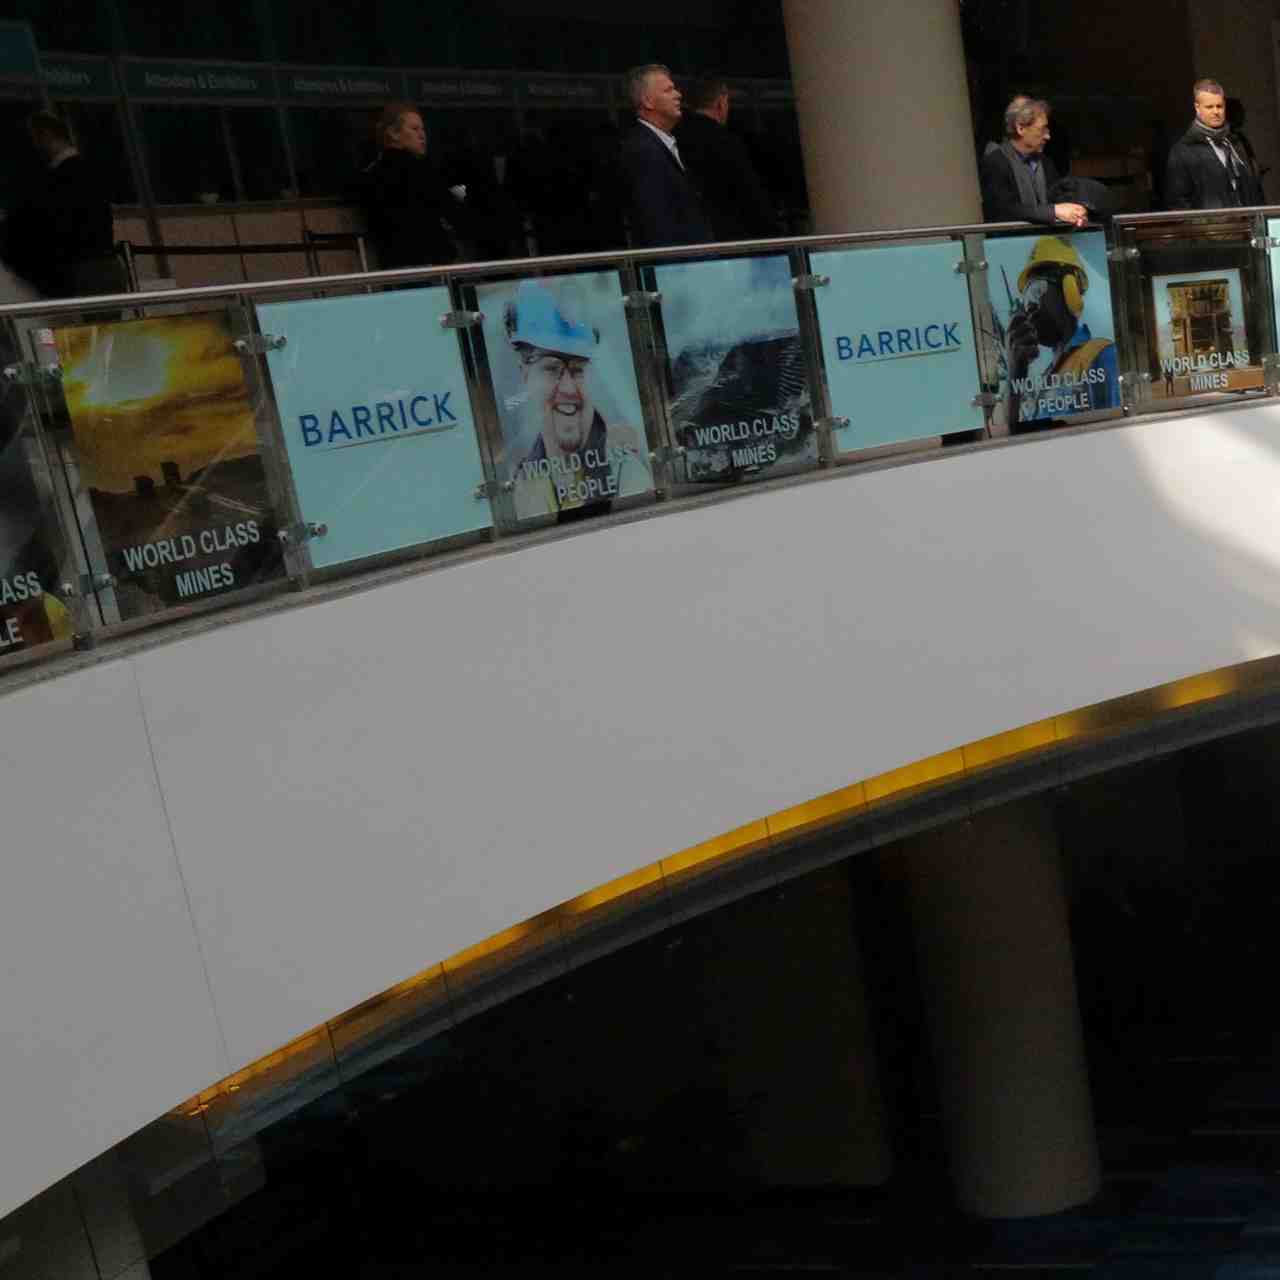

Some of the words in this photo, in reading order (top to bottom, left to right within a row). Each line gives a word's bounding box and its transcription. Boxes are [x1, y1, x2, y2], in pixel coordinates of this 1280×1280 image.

[836, 322, 961, 361] BARRICK
[1160, 353, 1206, 374] WORLD
[1210, 349, 1250, 369] CLASS
[1011, 371, 1062, 395] WORLD
[1063, 367, 1106, 388] CLASS
[1190, 373, 1229, 391] MINES
[1039, 391, 1090, 414] PEOPLE
[299, 391, 457, 447] BARRICK
[695, 422, 750, 446] WORLD
[753, 414, 800, 437] CLASS
[522, 450, 581, 481] WORLD
[584, 442, 632, 470] CLASS
[732, 444, 777, 468] MINES
[557, 475, 618, 503] PEOPLE
[123, 535, 196, 573] WORLD
[200, 520, 261, 555] CLASS
[0, 571, 42, 606] ASS
[176, 562, 235, 598] MINES
